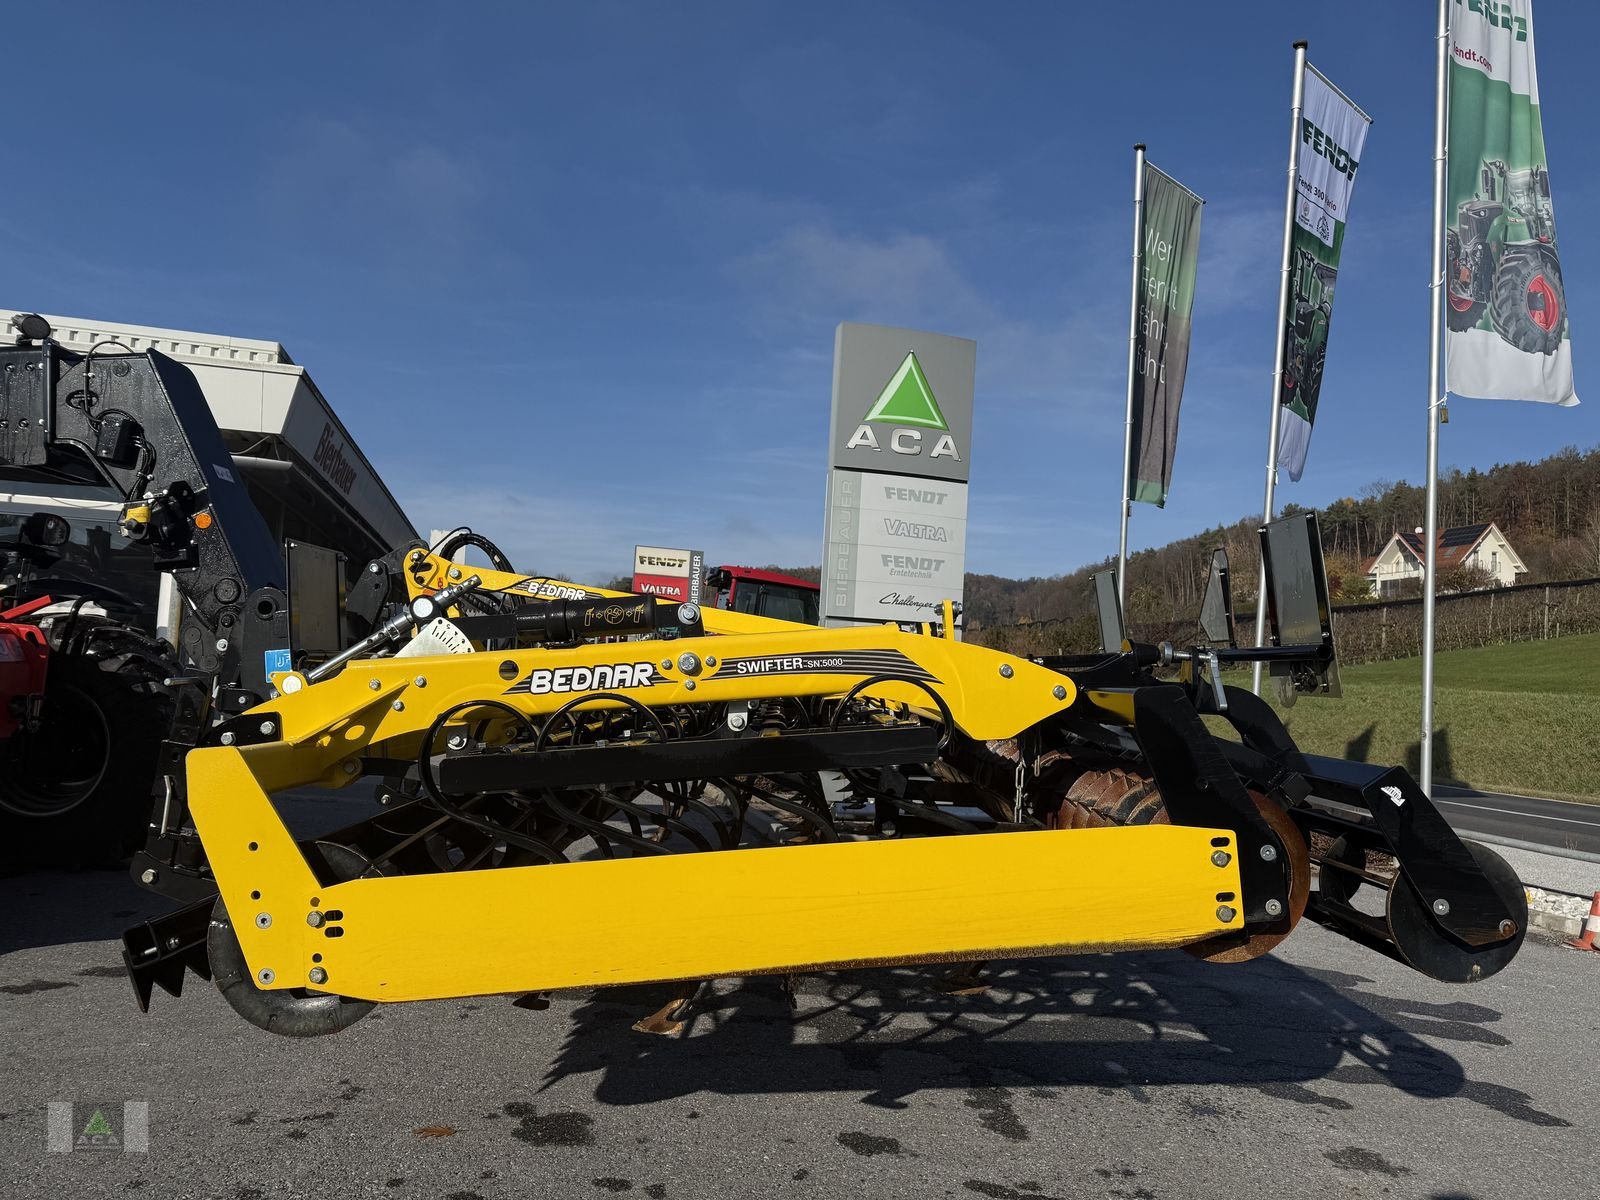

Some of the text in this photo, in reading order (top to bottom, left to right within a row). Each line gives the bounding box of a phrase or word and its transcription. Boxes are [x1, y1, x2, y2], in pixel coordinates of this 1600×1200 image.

[1302, 117, 1359, 182] FENDT
[1298, 175, 1313, 194] Fendt
[1145, 223, 1172, 263] Wer
[1136, 344, 1166, 384] füht
[845, 424, 962, 462] ACA
[313, 422, 358, 495] Bierbauer
[884, 486, 948, 505] FENDT
[884, 518, 947, 542] VALTRA
[836, 480, 853, 607] BIERBAUER
[639, 555, 687, 568] FENDT
[881, 554, 945, 572] FENDT
[690, 555, 701, 605] BIERBAUER
[889, 568, 932, 579] Erntetechnik
[527, 581, 586, 600] BEDNAR
[641, 583, 681, 596] VALTRA
[879, 592, 938, 611] Challenger
[736, 657, 804, 674] SWIFTER
[529, 662, 654, 694] BEDNAR
